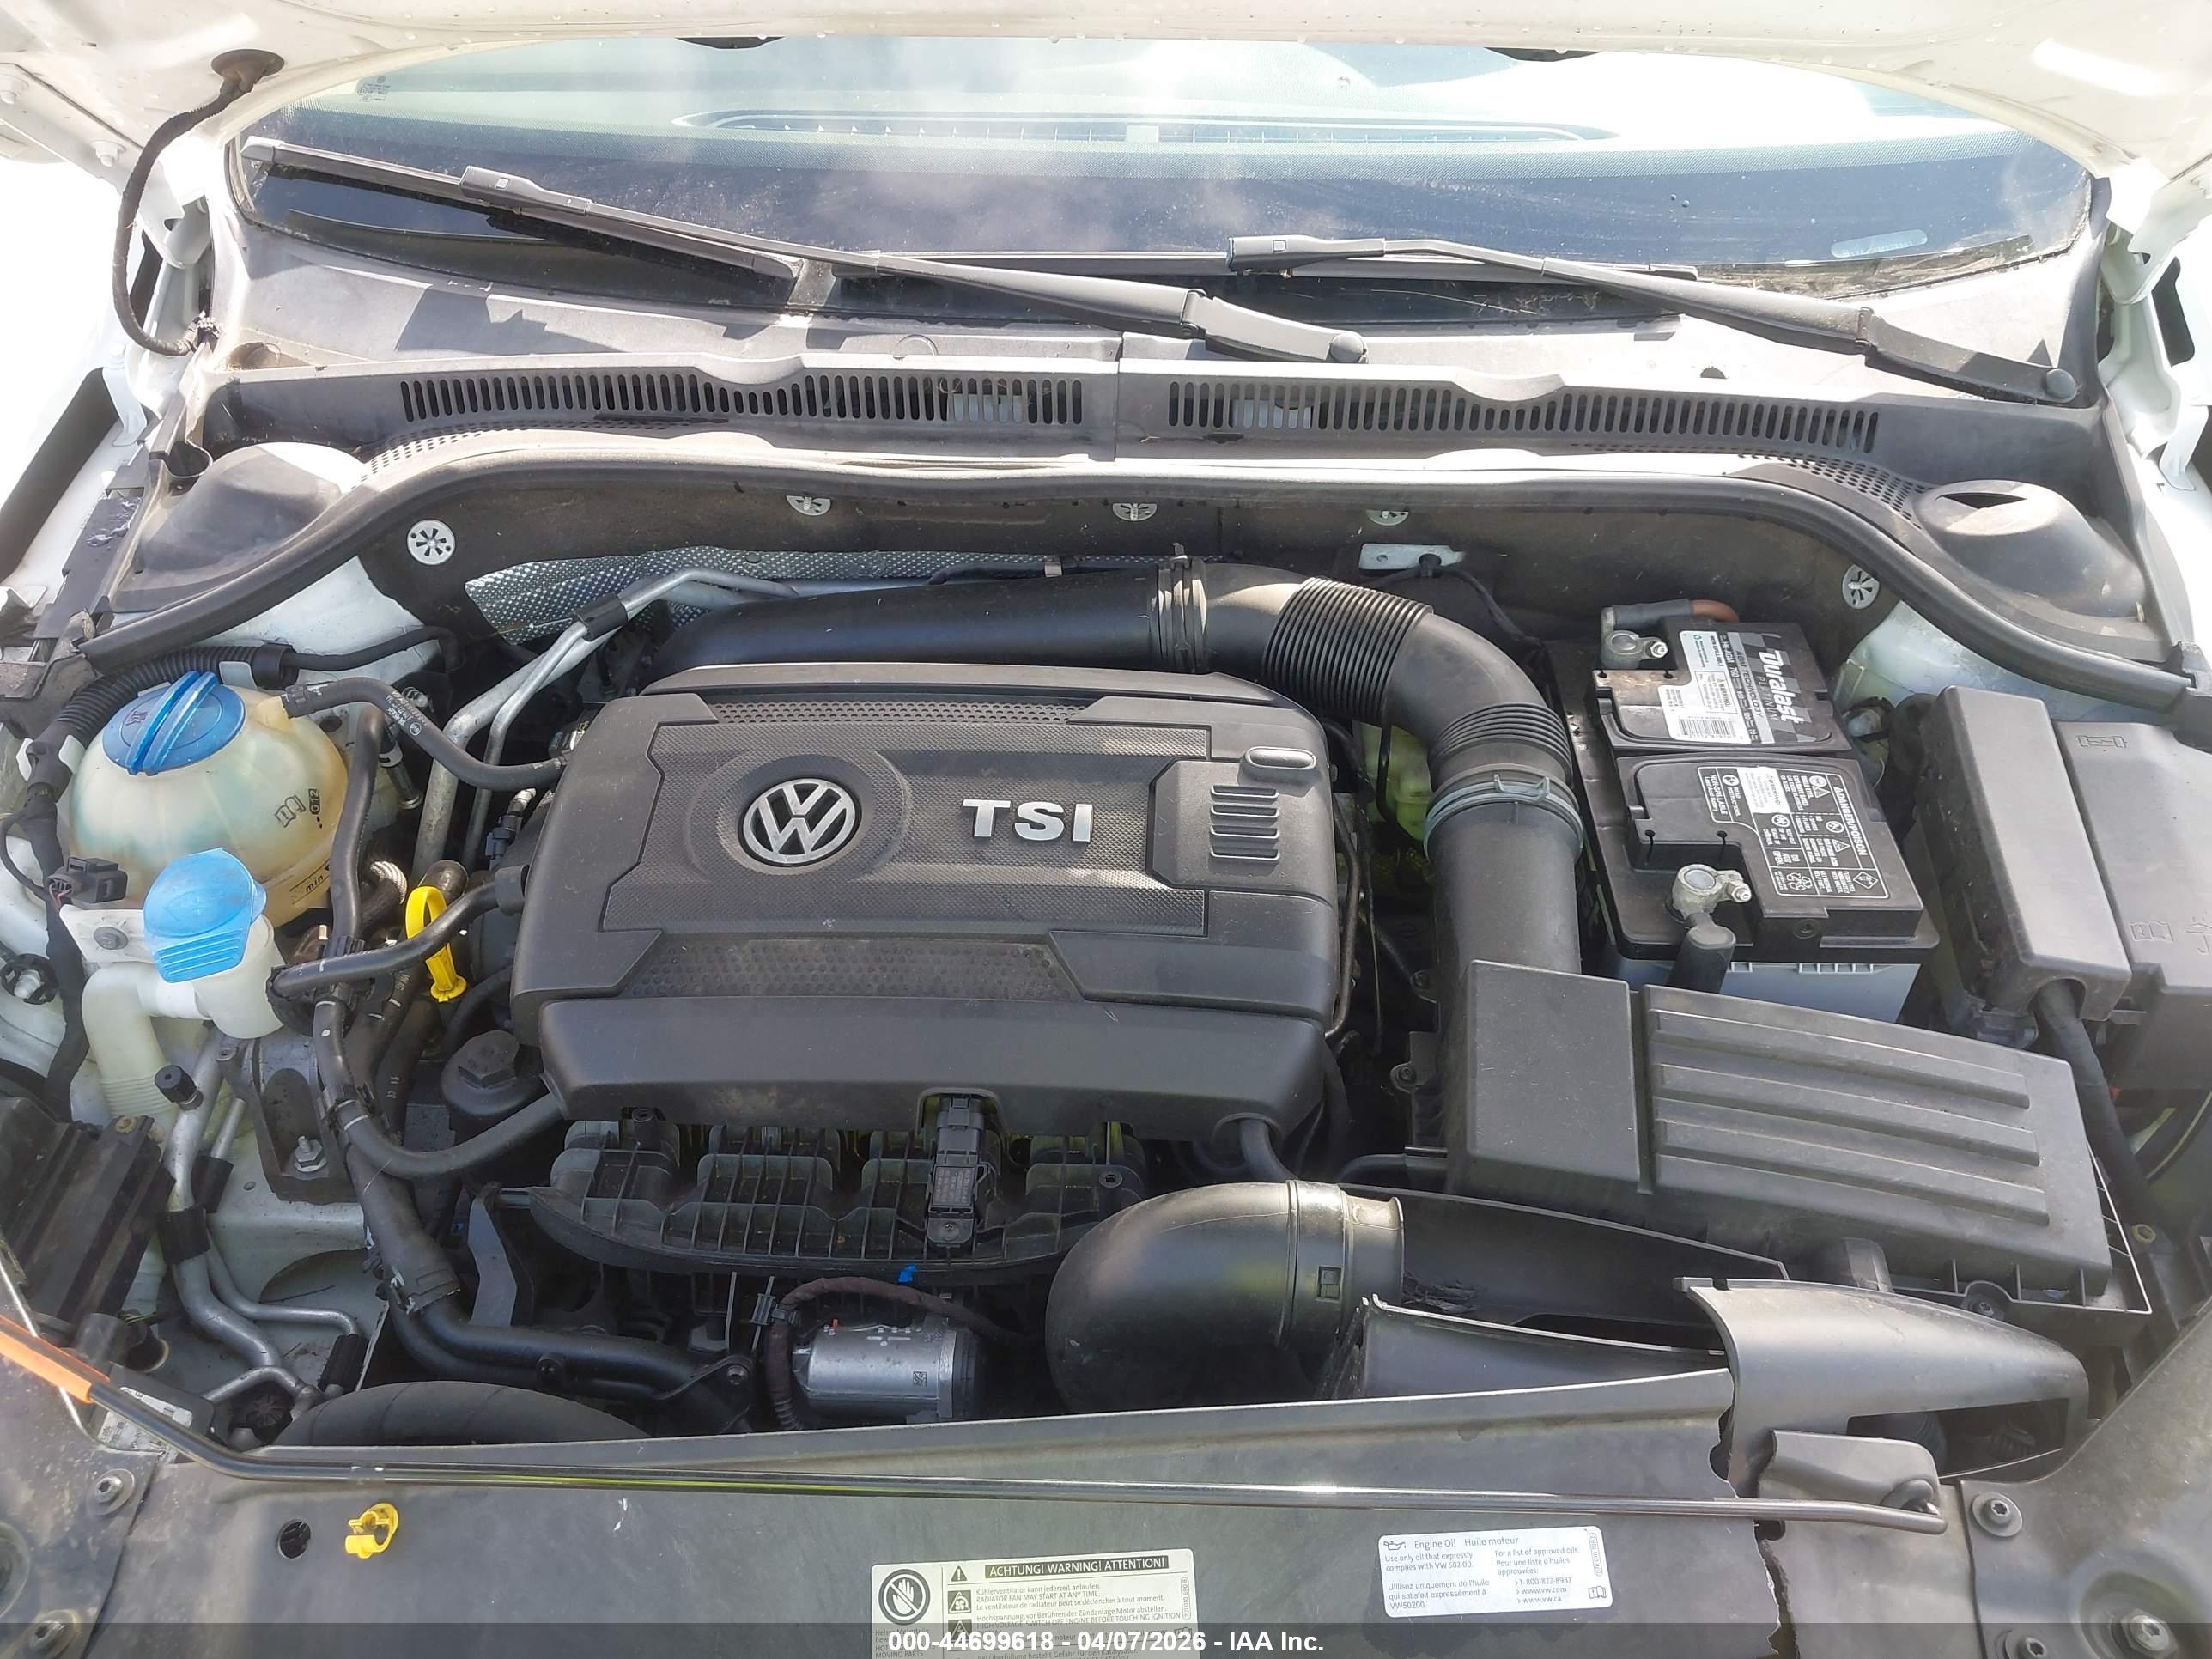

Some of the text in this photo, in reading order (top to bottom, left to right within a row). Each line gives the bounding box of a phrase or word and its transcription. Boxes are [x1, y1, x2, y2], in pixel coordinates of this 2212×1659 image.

[1735, 650, 1747, 667] AGM
[1742, 670, 1764, 719] TECHNOLOGY
[1759, 650, 1804, 724] Duralast
[1710, 775, 1729, 815] NON-SPILLABLE
[310, 790, 319, 813] G12
[962, 799, 1093, 844] TSI
[1837, 793, 1869, 856] DANGER/POISON
[1782, 853, 1792, 864] NOT
[306, 874, 324, 893] min
[1414, 1536, 1518, 1551] Engine Oil Huile moteur
[1399, 1553, 1413, 1563] only
[1441, 1552, 1473, 1561] expressly
[1534, 1547, 1565, 1557] approved
[989, 1557, 1165, 1577] ACHTUNG! WARNING! ATTENTION!
[1386, 1564, 1416, 1572] complies
[1043, 1583, 1071, 1592] jederzeit
[1415, 1580, 1457, 1589] uniquement
[1522, 1586, 1567, 1595] www.vw.com
[1389, 1593, 1400, 1601] qui
[984, 1602, 1018, 1611] ventilateur
[1029, 1600, 1057, 1608] radiateur
[1058, 1599, 1073, 1607] peut
[1082, 1597, 1115, 1606] déclencher
[1078, 1608, 1115, 1618] Zündanlage
[1116, 1613, 1150, 1622] TOUCHING
[1151, 1612, 1181, 1620] IGNITION
